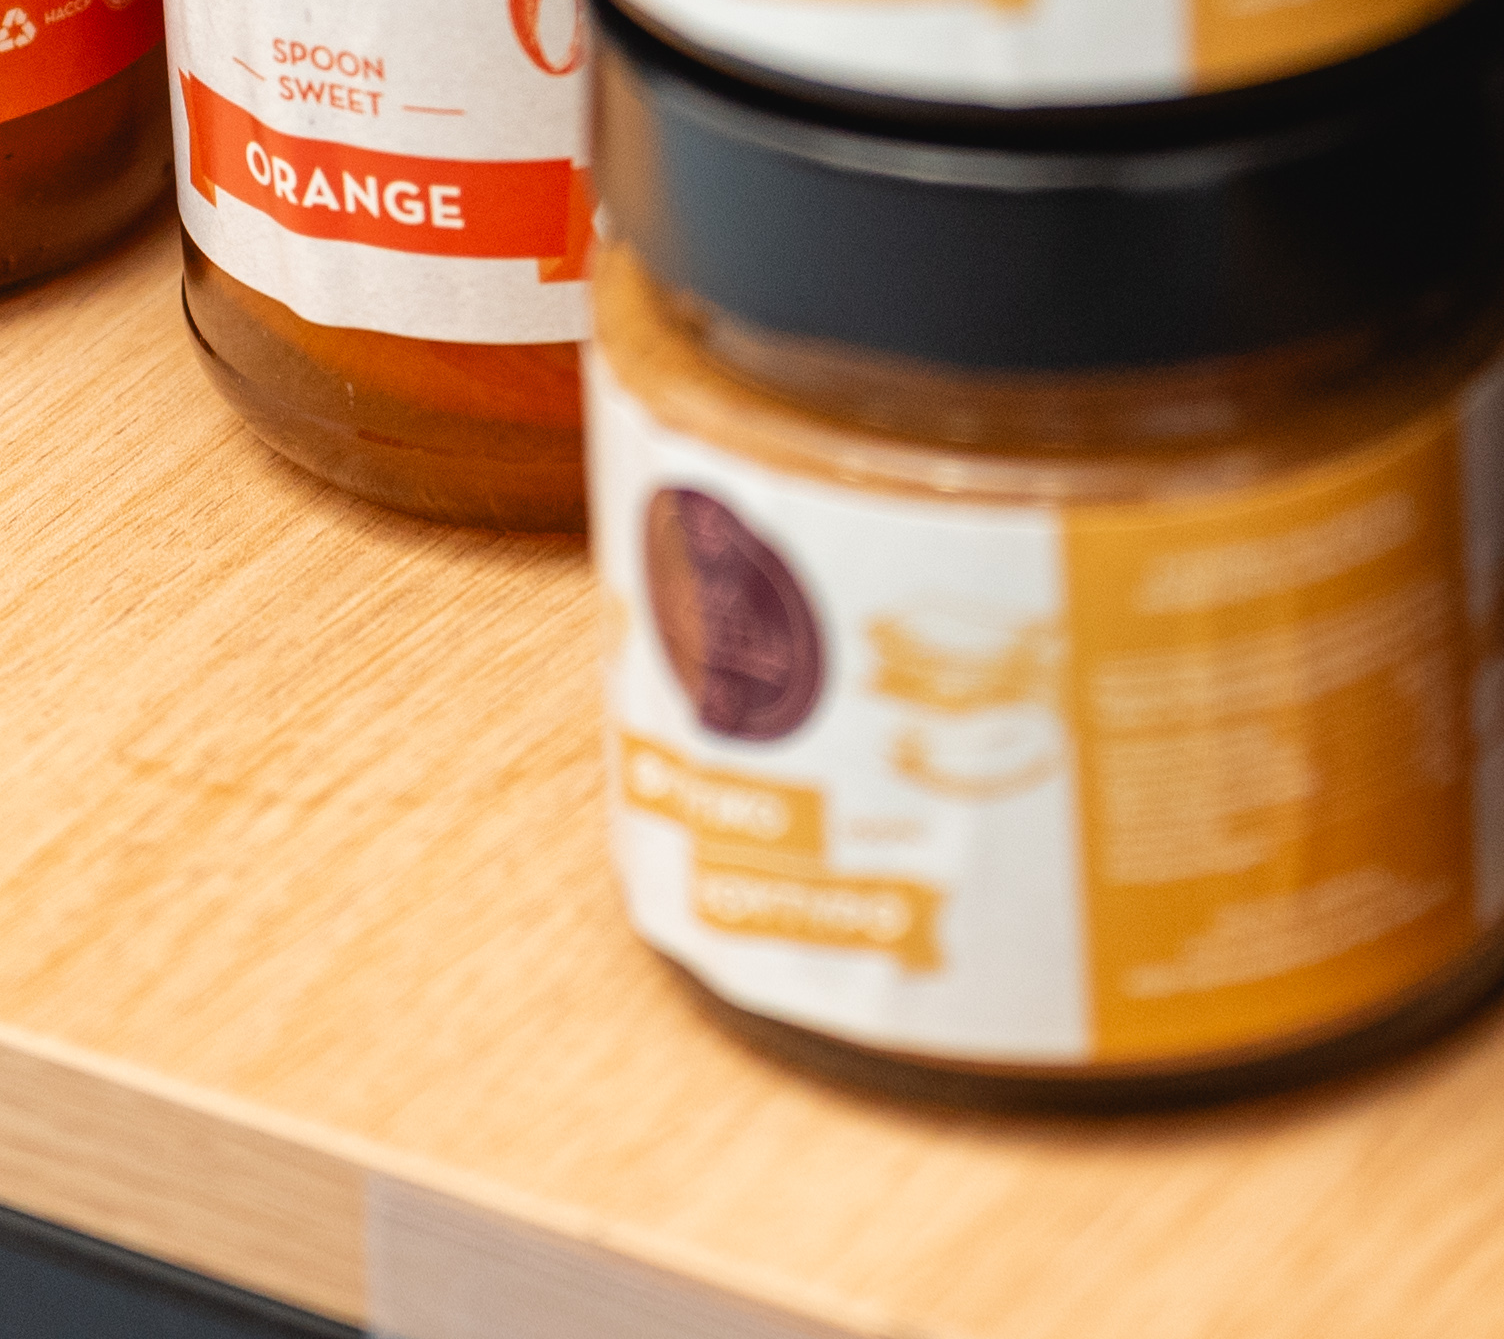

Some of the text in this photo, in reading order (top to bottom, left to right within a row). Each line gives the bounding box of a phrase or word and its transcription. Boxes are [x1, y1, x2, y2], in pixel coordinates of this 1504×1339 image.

[272, 37, 386, 82] SPOON
[279, 76, 386, 117] SWEET
[245, 138, 466, 231] ORANGE
